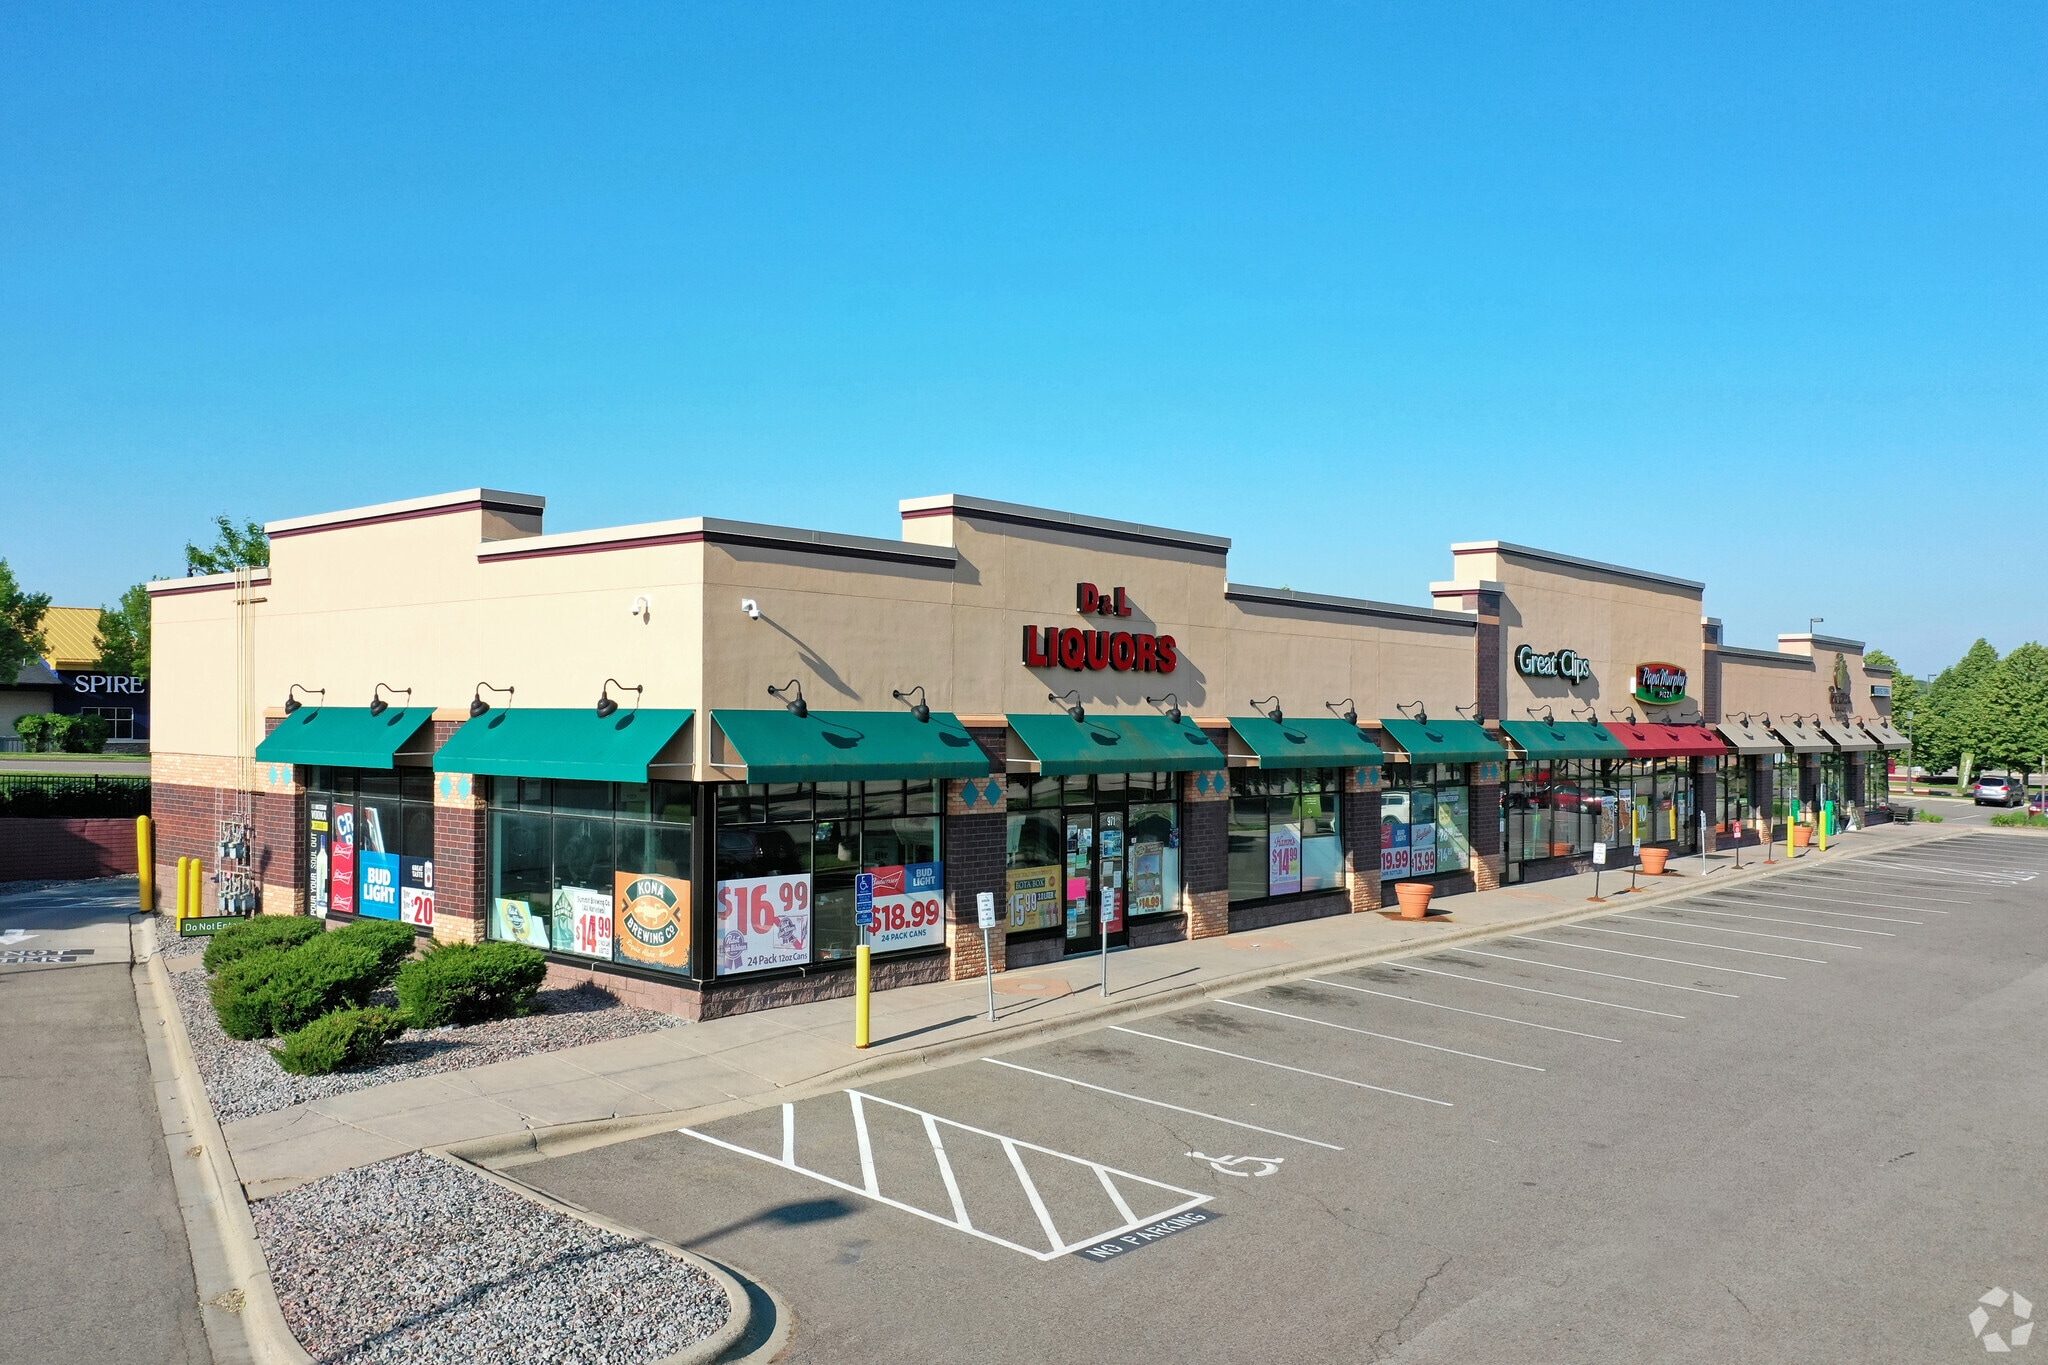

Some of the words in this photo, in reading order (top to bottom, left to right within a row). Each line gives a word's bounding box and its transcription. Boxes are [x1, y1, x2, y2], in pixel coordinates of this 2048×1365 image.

[1023, 625, 1177, 673] LIQUORS
[1518, 646, 1558, 676] Great
[1560, 650, 1590, 685] Clips
[75, 675, 145, 694] SPIRE
[1643, 667, 1660, 694] Papa
[1107, 816, 1116, 827] 971
[368, 868, 391, 886] BUD
[913, 876, 936, 887] LIGHT
[916, 868, 933, 877] BUD
[637, 881, 664, 899] KONA
[1016, 880, 1031, 890] BOTA
[1033, 878, 1045, 887] BOX
[363, 885, 395, 904] LIGHT
[866, 899, 940, 936] $18.99
[185, 923, 198, 932] Do
[200, 922, 215, 931] Not
[627, 917, 665, 944] BREWING
[891, 931, 907, 940] PACK
[909, 929, 927, 938] CANS
[748, 957, 758, 966] 24
[759, 954, 777, 965] Pack
[778, 954, 792, 962] 12oz
[793, 952, 808, 960] Cans
[1086, 1244, 1123, 1258] NO
[1120, 1212, 1206, 1245] PARKING
